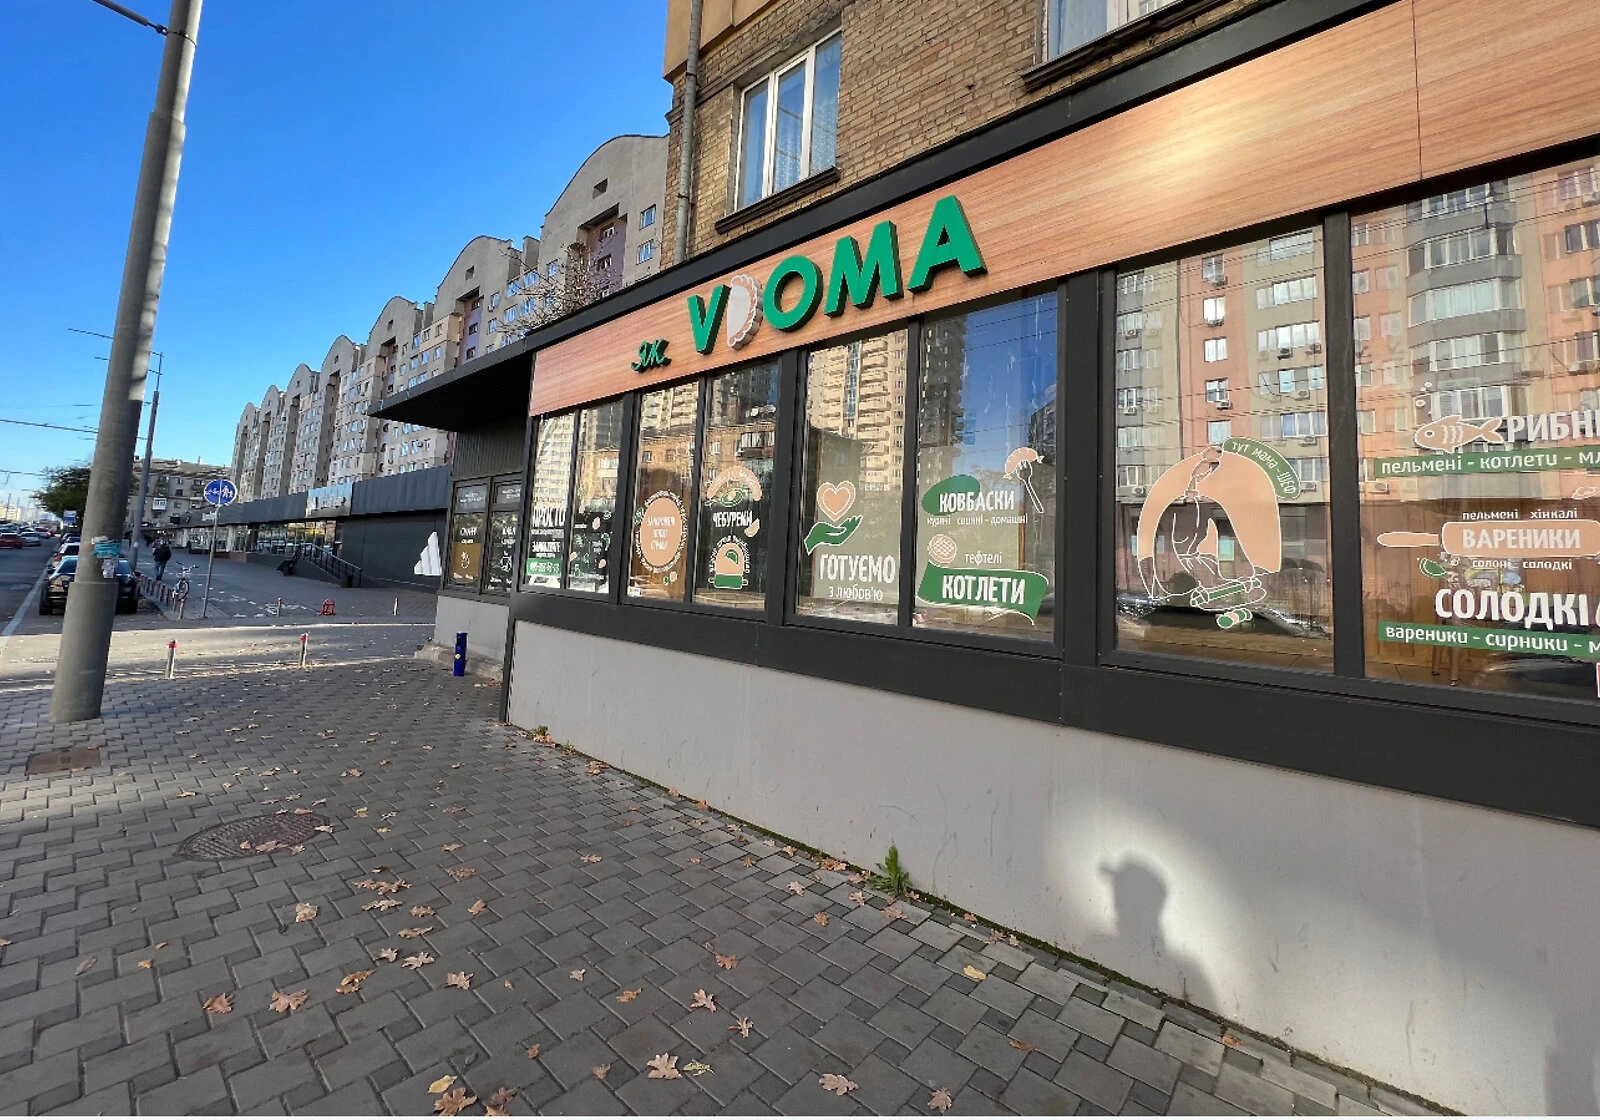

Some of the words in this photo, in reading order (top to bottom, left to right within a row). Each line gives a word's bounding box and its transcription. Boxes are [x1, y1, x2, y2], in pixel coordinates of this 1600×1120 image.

[1251, 448, 1278, 469] мама
[1381, 456, 1462, 474] пельмені
[1480, 452, 1558, 470] котлети
[939, 490, 1015, 513] КОВБАСКИ
[712, 510, 753, 528] ЧЕБУРЕКИ
[990, 512, 1029, 526] домашні
[1462, 508, 1519, 520] пельмені
[1529, 507, 1578, 519] хінкалі
[1462, 528, 1581, 549] ВАРЕНИКИ
[820, 553, 896, 584] ГОТУЄМО
[964, 550, 1003, 566] тефтелі
[1522, 558, 1573, 571] солодкі
[836, 584, 884, 601] любов'ю
[941, 574, 1026, 605] КОТЛЕТИ
[1435, 588, 1590, 631] СОЛОДКІ
[1386, 626, 1468, 644] вареники
[1485, 633, 1568, 651] сирники
